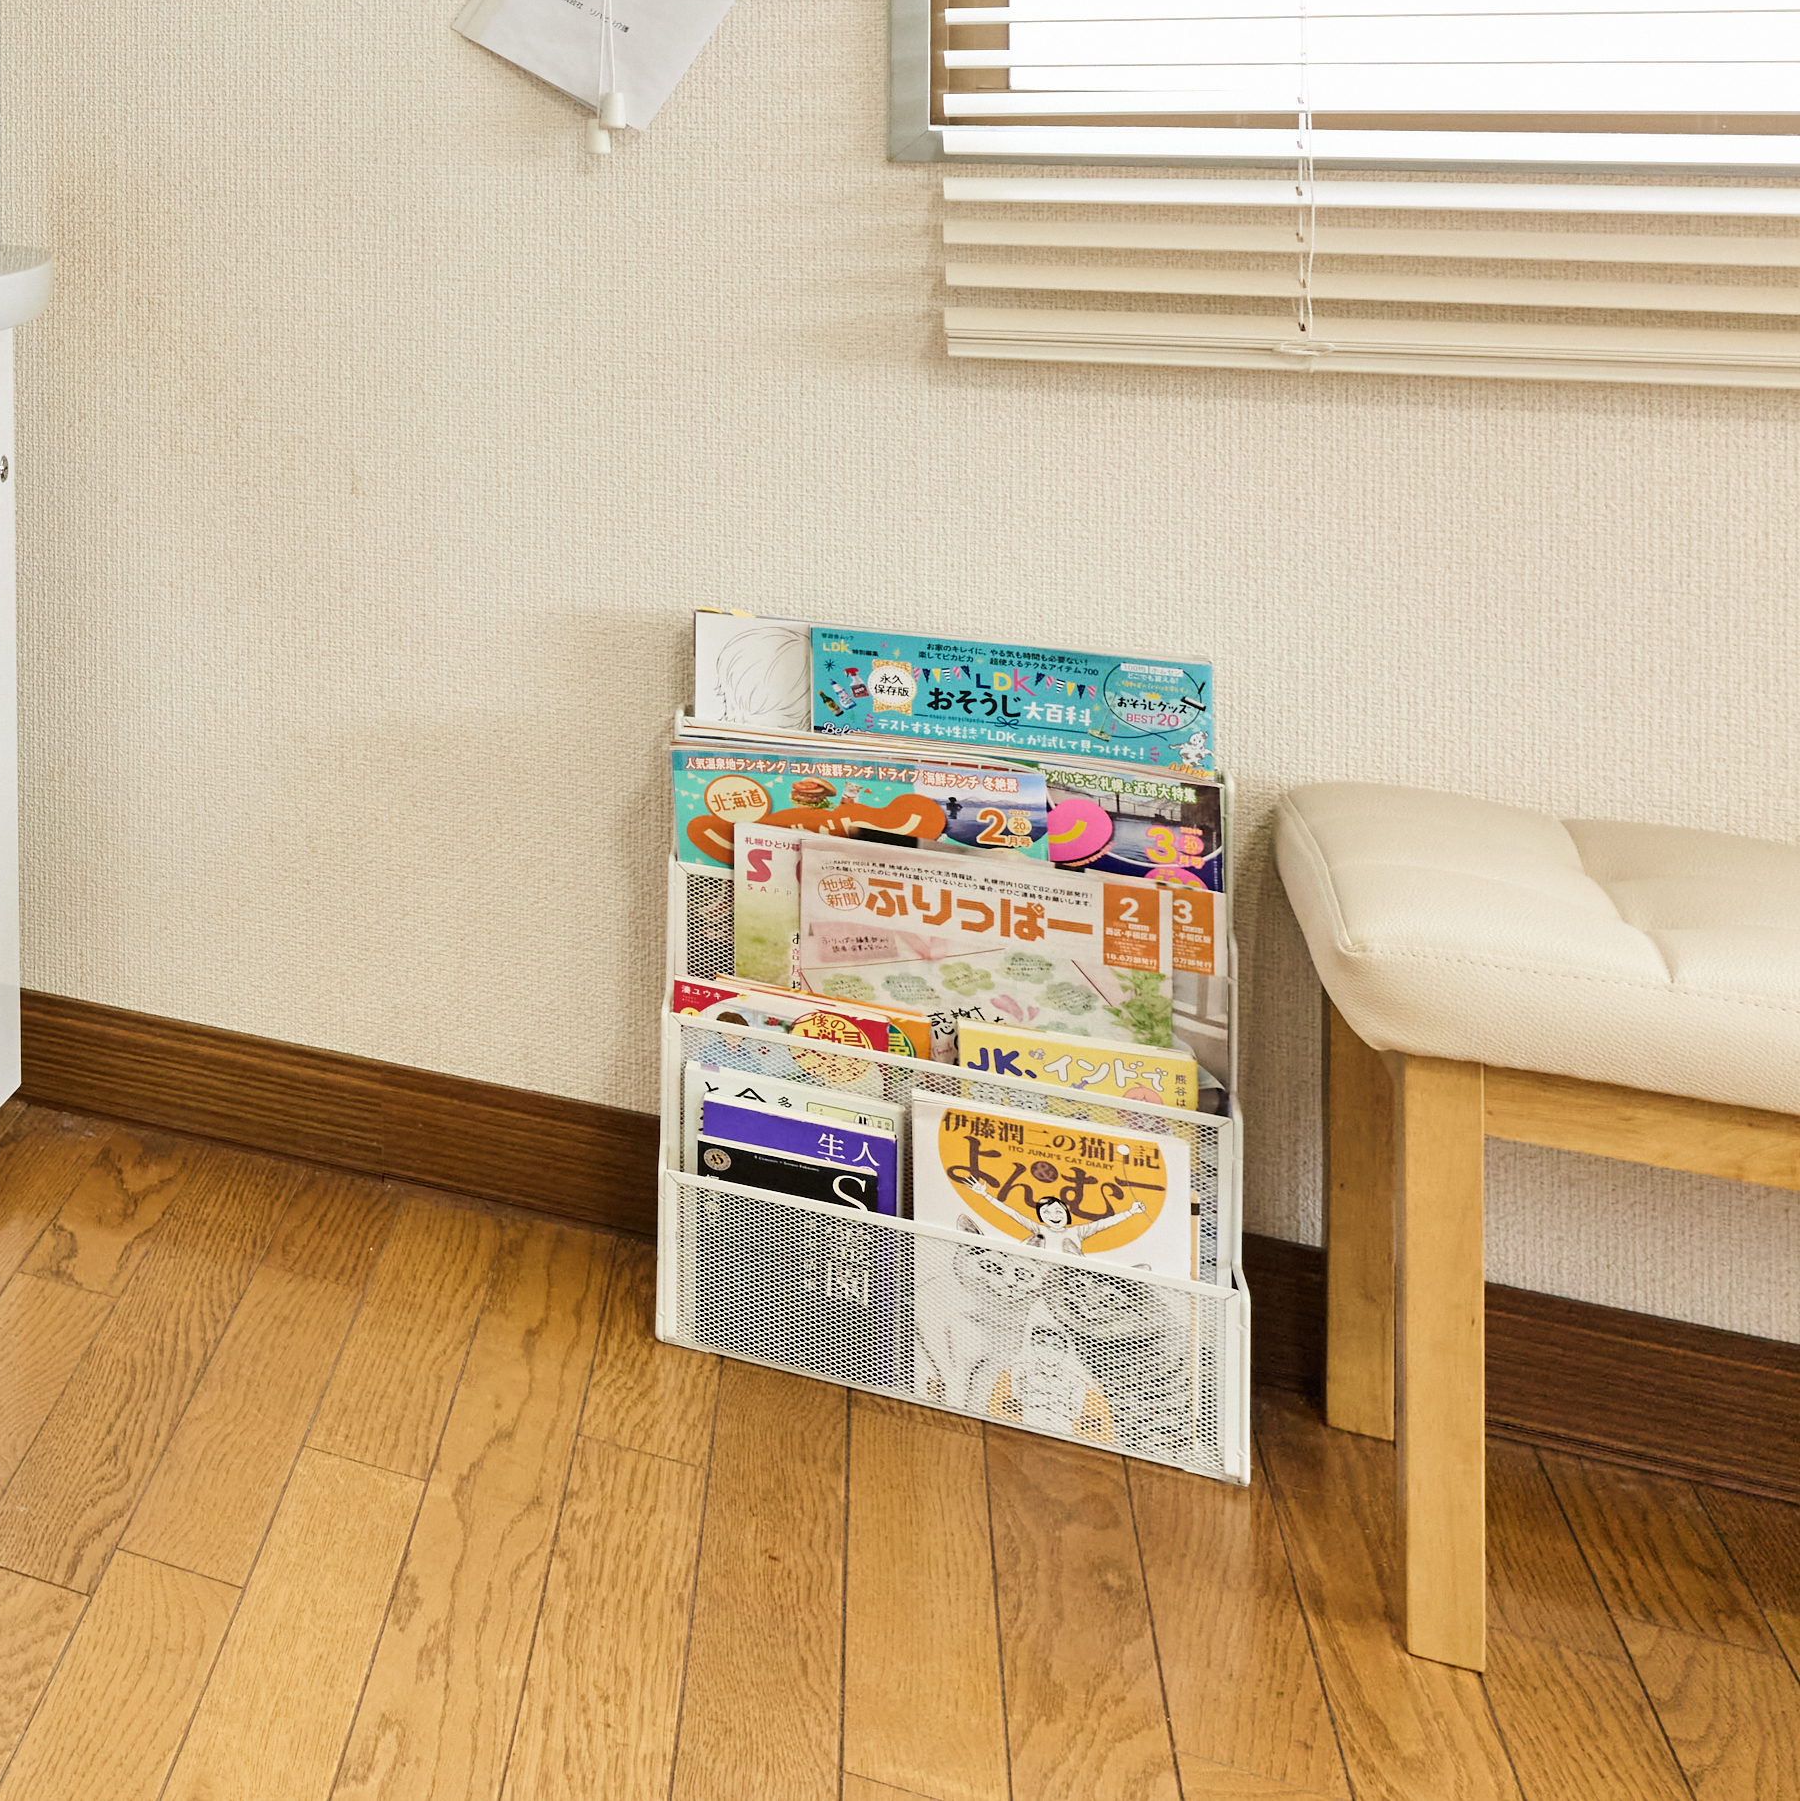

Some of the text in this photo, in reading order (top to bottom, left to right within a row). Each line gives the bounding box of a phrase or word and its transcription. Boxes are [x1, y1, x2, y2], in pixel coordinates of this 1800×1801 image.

[822, 639, 852, 654] LDK
[874, 684, 910, 698] 保存版
[879, 673, 905, 685] 永久
[975, 668, 1038, 697] LDK
[926, 687, 1093, 727] おそうじ 大百科
[1118, 697, 1190, 714] おそうじグッズ
[686, 756, 1020, 794] 人気温泉地ランキング コスパ抜群ランチ ドライブ 海鮮ランチ 冬絶景
[711, 788, 766, 812] 北海道
[1100, 776, 1198, 804] 札幌&近郊大特集
[976, 807, 1008, 846] 2
[1008, 836, 1032, 848] 月号
[1145, 826, 1176, 864] 3
[821, 876, 856, 892] 地域
[826, 892, 860, 908] 新聞
[864, 877, 1094, 942] ふりっぱー
[1119, 897, 1139, 922] 2
[1172, 899, 1193, 924] 3
[681, 984, 722, 1000] 湊ユウキ
[942, 1110, 1162, 1170] 伊藤潤二の猫日記
[1008, 1144, 1115, 1171] ITO JUNJI'S CAT DIARY
